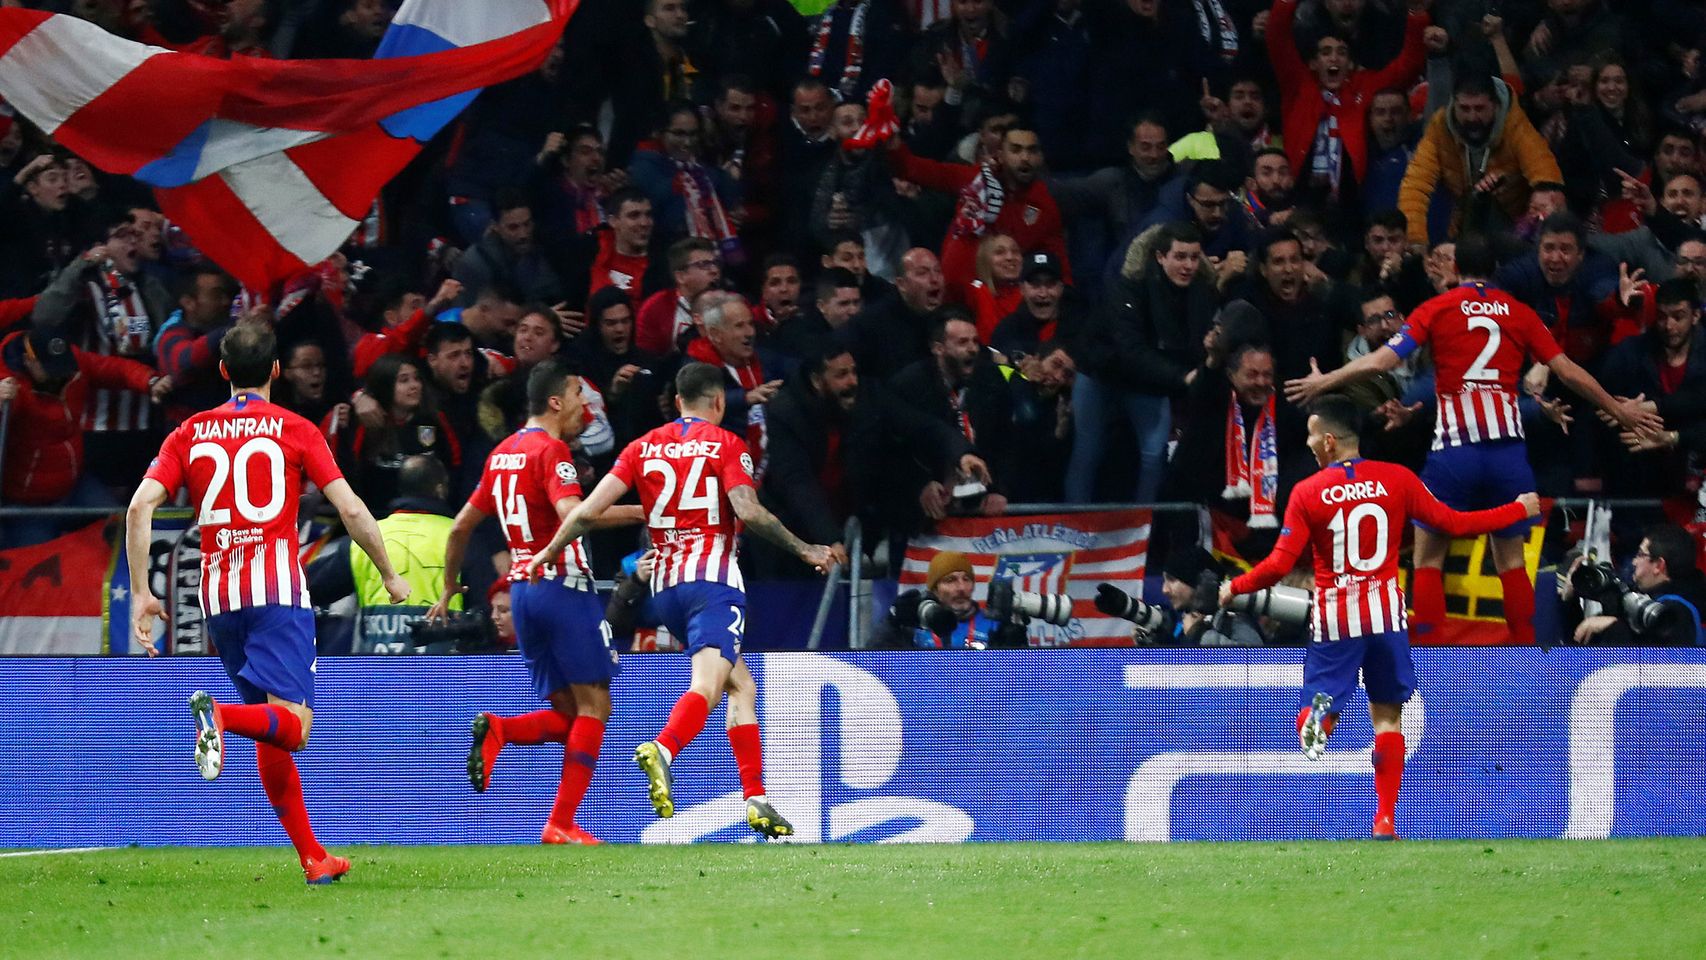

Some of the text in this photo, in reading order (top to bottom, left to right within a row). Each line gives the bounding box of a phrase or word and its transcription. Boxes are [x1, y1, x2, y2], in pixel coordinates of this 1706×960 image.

[1462, 316, 1501, 380] 2
[192, 416, 283, 441] JUANFRAN
[189, 437, 286, 526] 20
[491, 473, 534, 543] 14
[643, 456, 720, 529] 24
[1321, 480, 1388, 505] CORREA
[1326, 502, 1388, 574] 10
